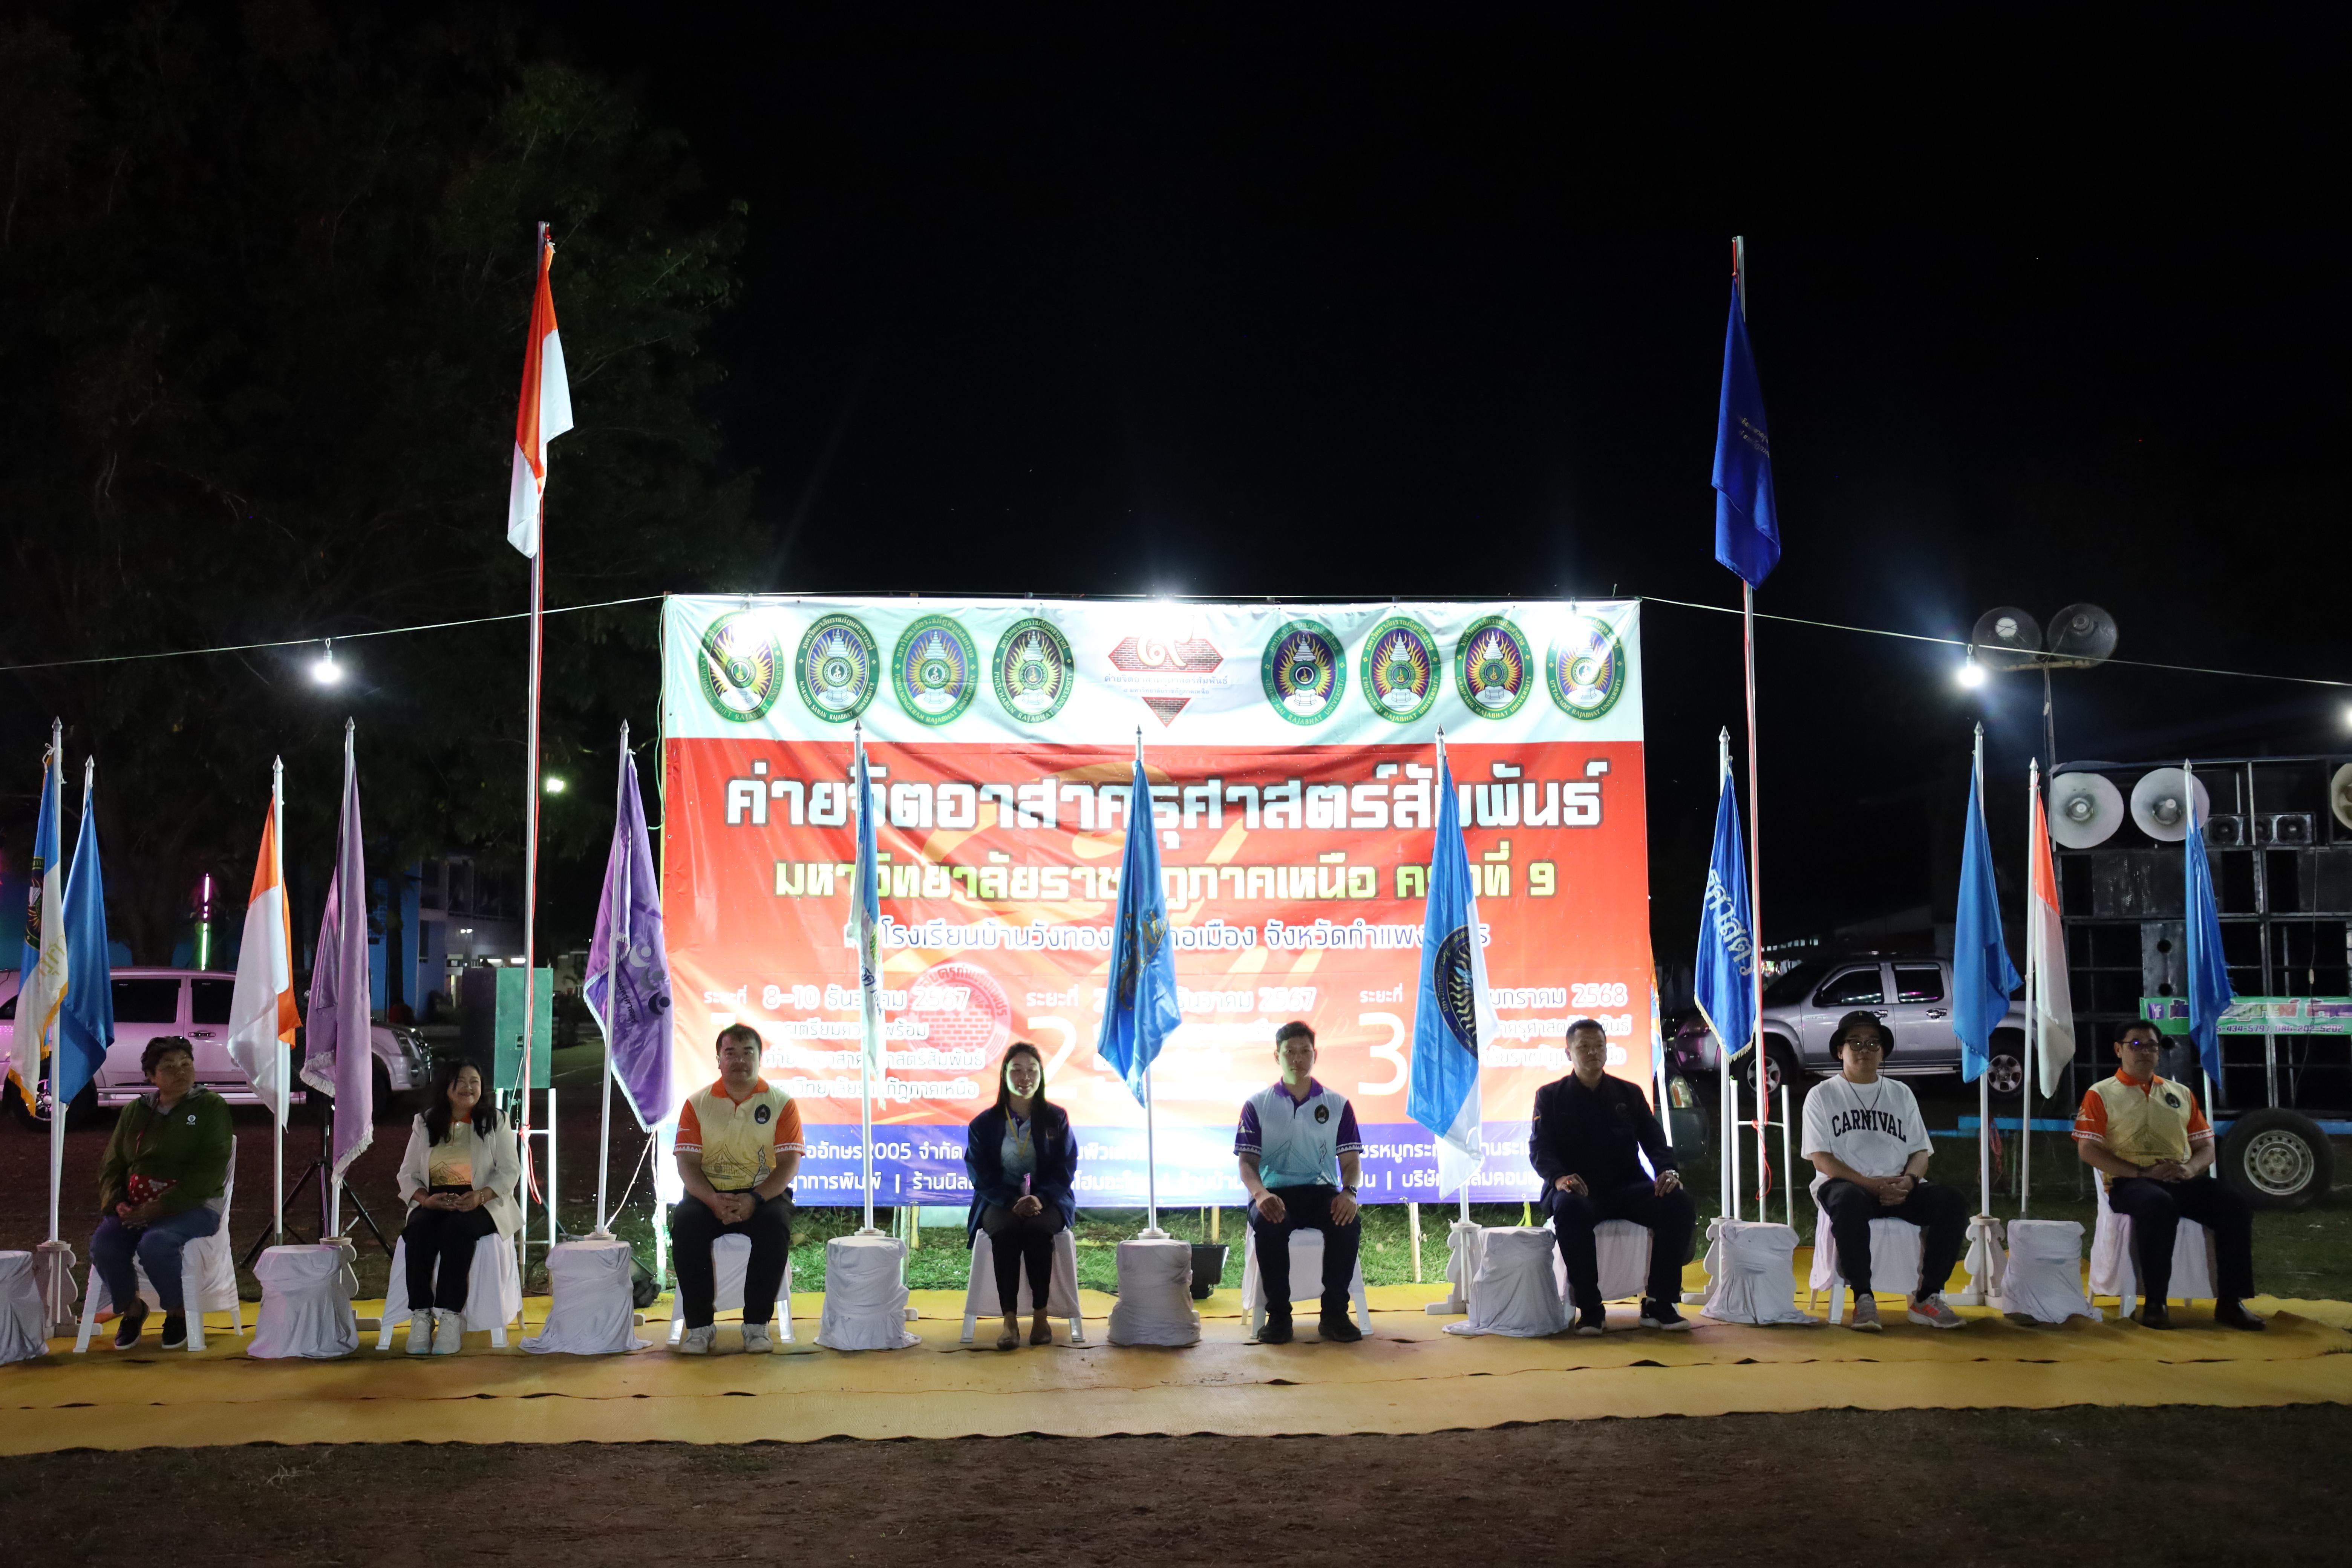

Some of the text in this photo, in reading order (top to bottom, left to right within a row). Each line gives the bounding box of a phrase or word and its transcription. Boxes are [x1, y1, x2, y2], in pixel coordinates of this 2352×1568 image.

[700, 657, 783, 721] KAMPHAENG PHET RAJABHAT UNIVERSITY
[799, 680, 875, 721] NAKHON SAWAN RAJABHAT UNIVERSITY
[926, 710, 958, 724] RAJABHAT
[957, 674, 976, 711] UNIVERSITY
[993, 671, 1073, 723] PHETCHABUN RAJABHAT UNIVERSITY
[1265, 678, 1344, 726] CHIANG MAI RAJABHAT UNIVERSITY
[1362, 675, 1439, 722] CHIANGRAI RAJABHAT UNIVERSITY
[1456, 675, 1532, 719] LAMPANG RAJABHAT UNIVERSITY
[1550, 678, 1623, 718] UTTARADIT RAJABHAT UNIVERSITY
[774, 850, 1378, 910] มหาิทยาลัยราชฏภาคเหนือ
[1530, 862, 1556, 898] 9
[880, 917, 1112, 948] โรงเรียนบ้านวังทอง
[704, 985, 748, 1004] ระยะที่
[763, 985, 820, 1010] 8-10
[825, 984, 907, 1011] ธันวคม
[913, 987, 970, 1011] 2567
[1026, 985, 1079, 1007] ระยะที่
[1259, 986, 1317, 1012] 2567
[1360, 984, 1403, 1003] ระยะที่
[1571, 983, 1628, 1008] 2568
[1357, 1012, 1409, 1096] 3
[1832, 1109, 1906, 1143] CARNIVAL
[919, 1140, 963, 1160] จำกัด
[913, 1171, 975, 1190] ร้านนิล
